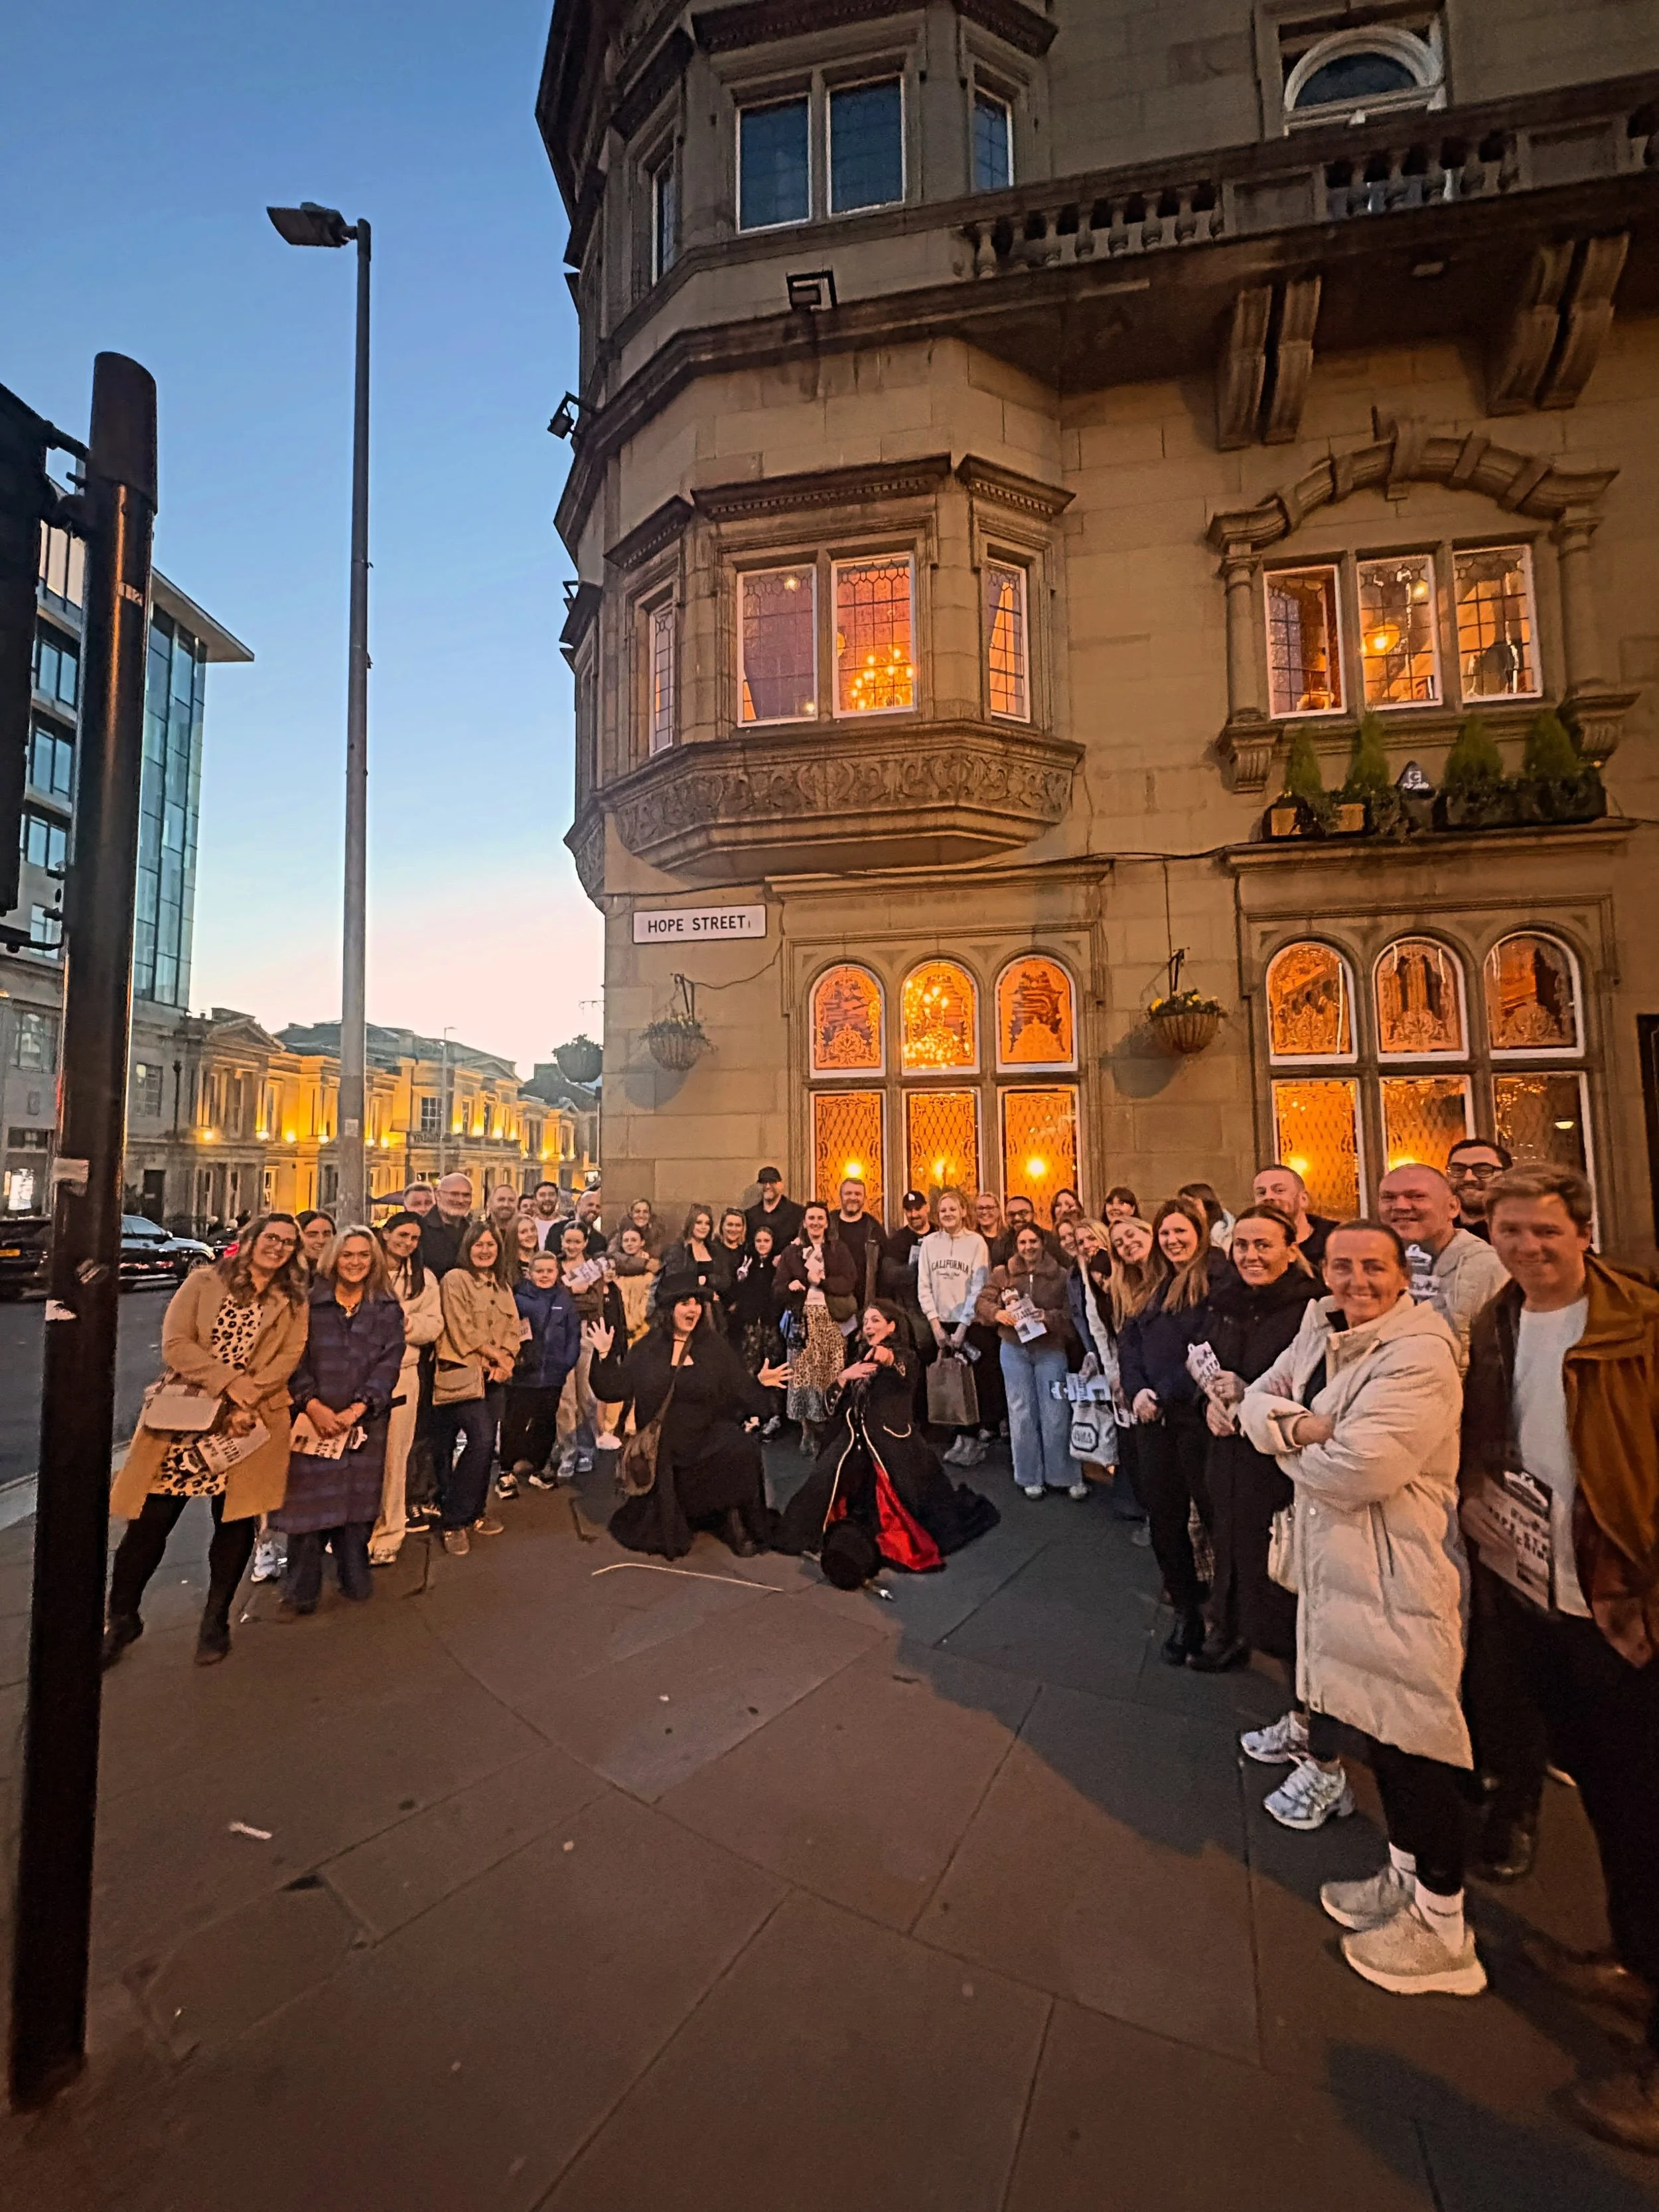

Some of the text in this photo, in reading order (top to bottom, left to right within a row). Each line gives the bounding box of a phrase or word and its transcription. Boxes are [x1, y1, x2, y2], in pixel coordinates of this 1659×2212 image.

[648, 919, 684, 933] HOPE
[692, 915, 746, 931] STREET
[931, 1259, 969, 1275] CALIFORNIA
